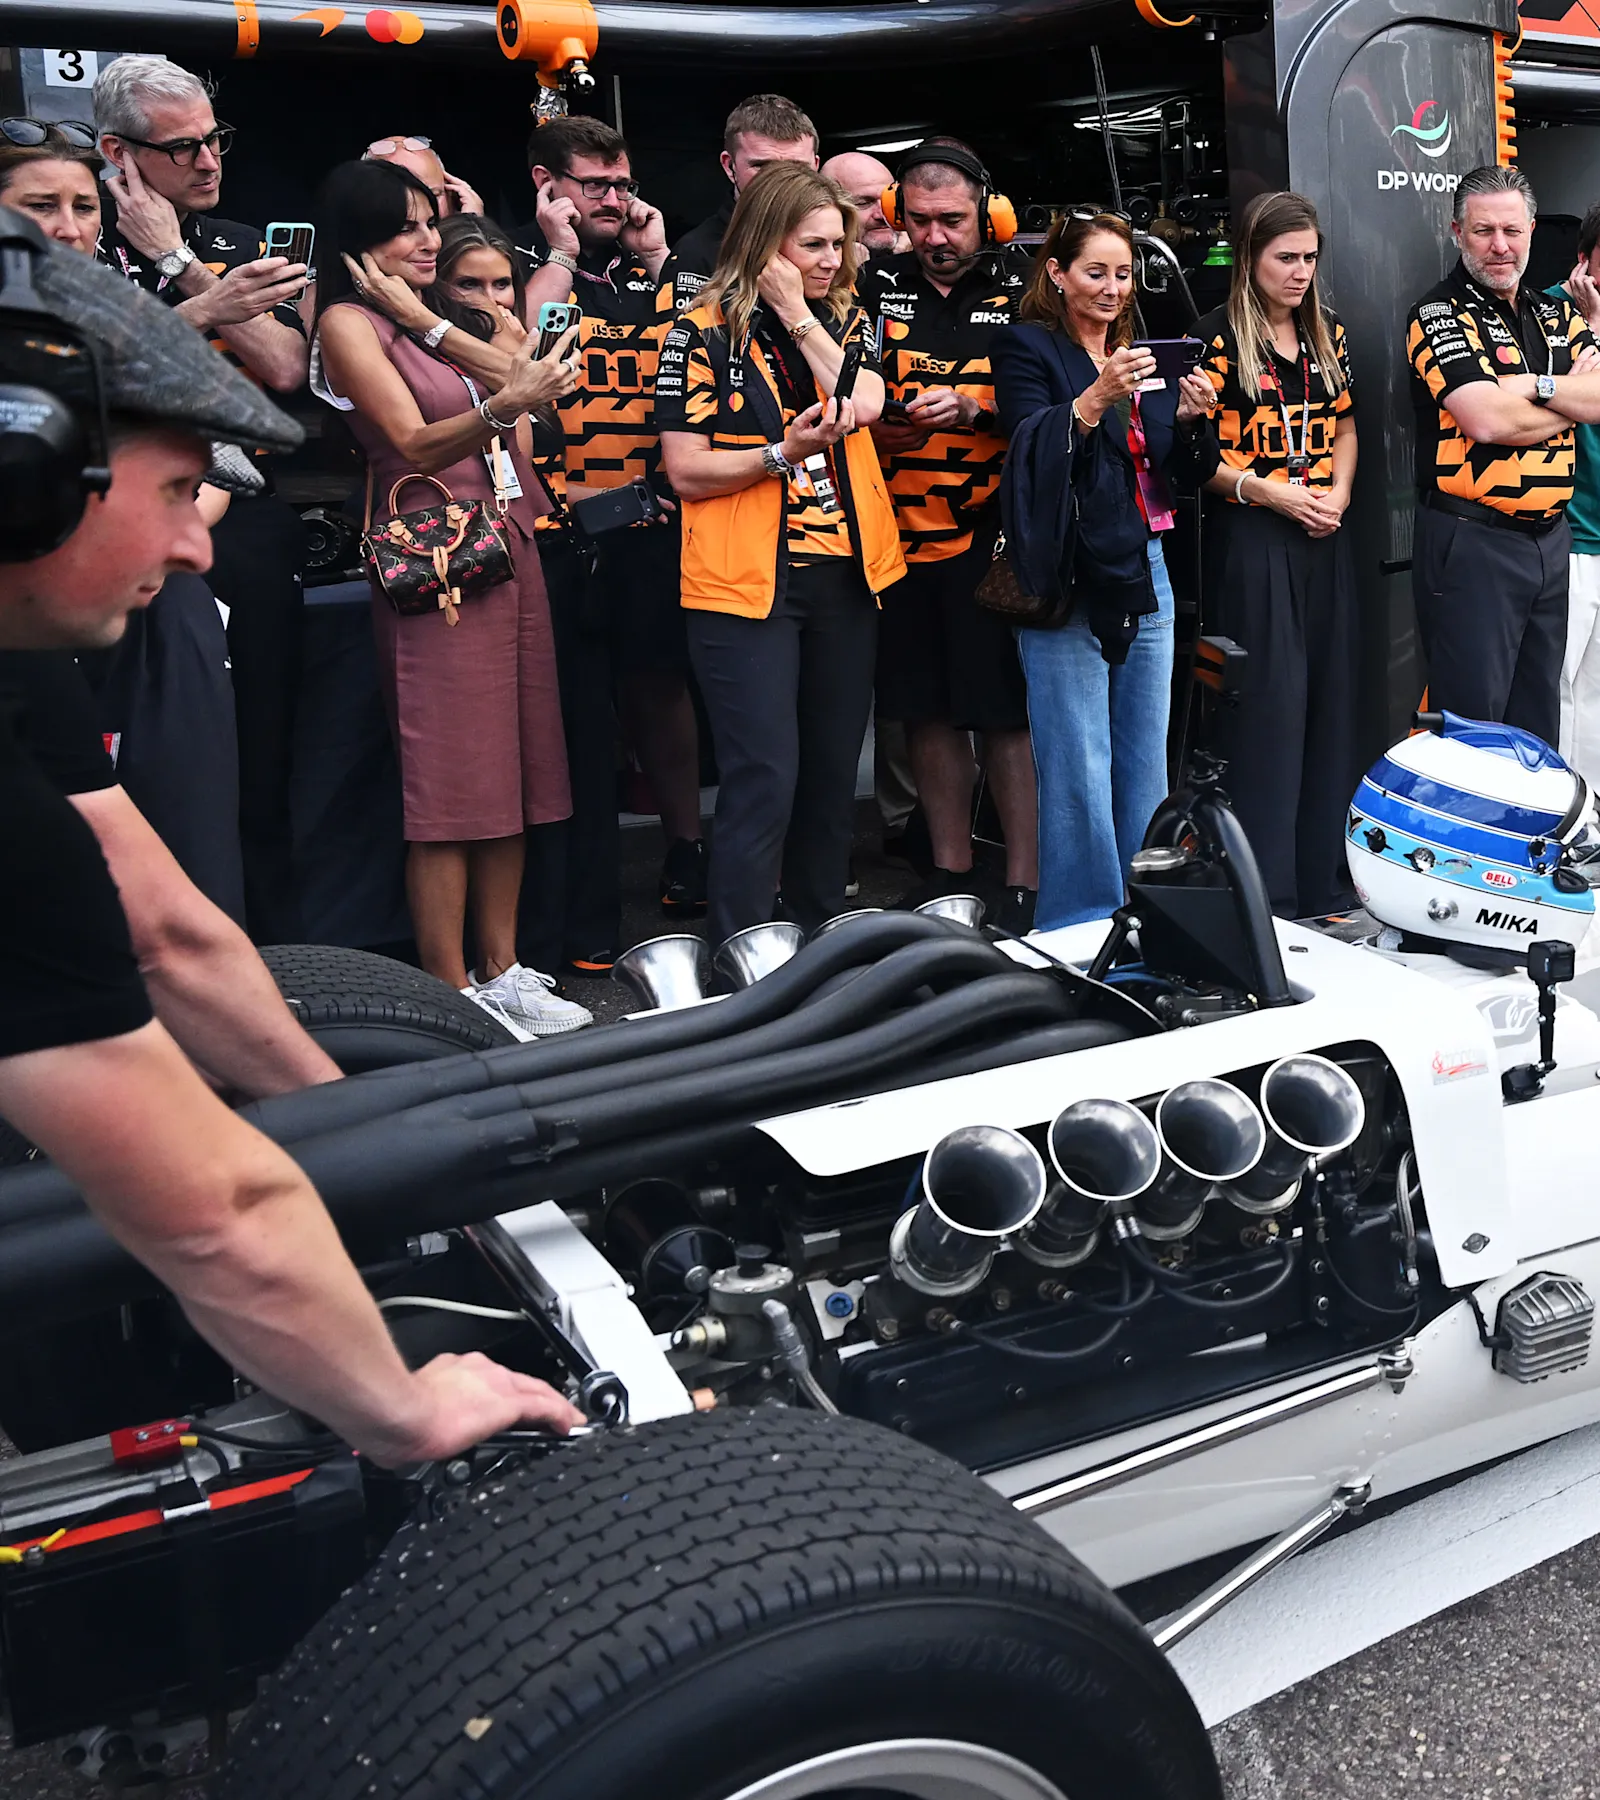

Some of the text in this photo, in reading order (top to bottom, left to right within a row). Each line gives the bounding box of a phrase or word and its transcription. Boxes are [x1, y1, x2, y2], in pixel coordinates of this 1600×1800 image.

[58, 49, 85, 82] 3
[1377, 170, 1409, 190] DP
[880, 292, 907, 300] Android
[880, 302, 915, 314] DELL
[1421, 304, 1450, 315] Hilton
[970, 311, 1011, 325] OKX
[1425, 318, 1459, 335] okta
[660, 349, 685, 364] okta
[1486, 872, 1514, 886] BELL
[1475, 908, 1538, 935] MIKA
